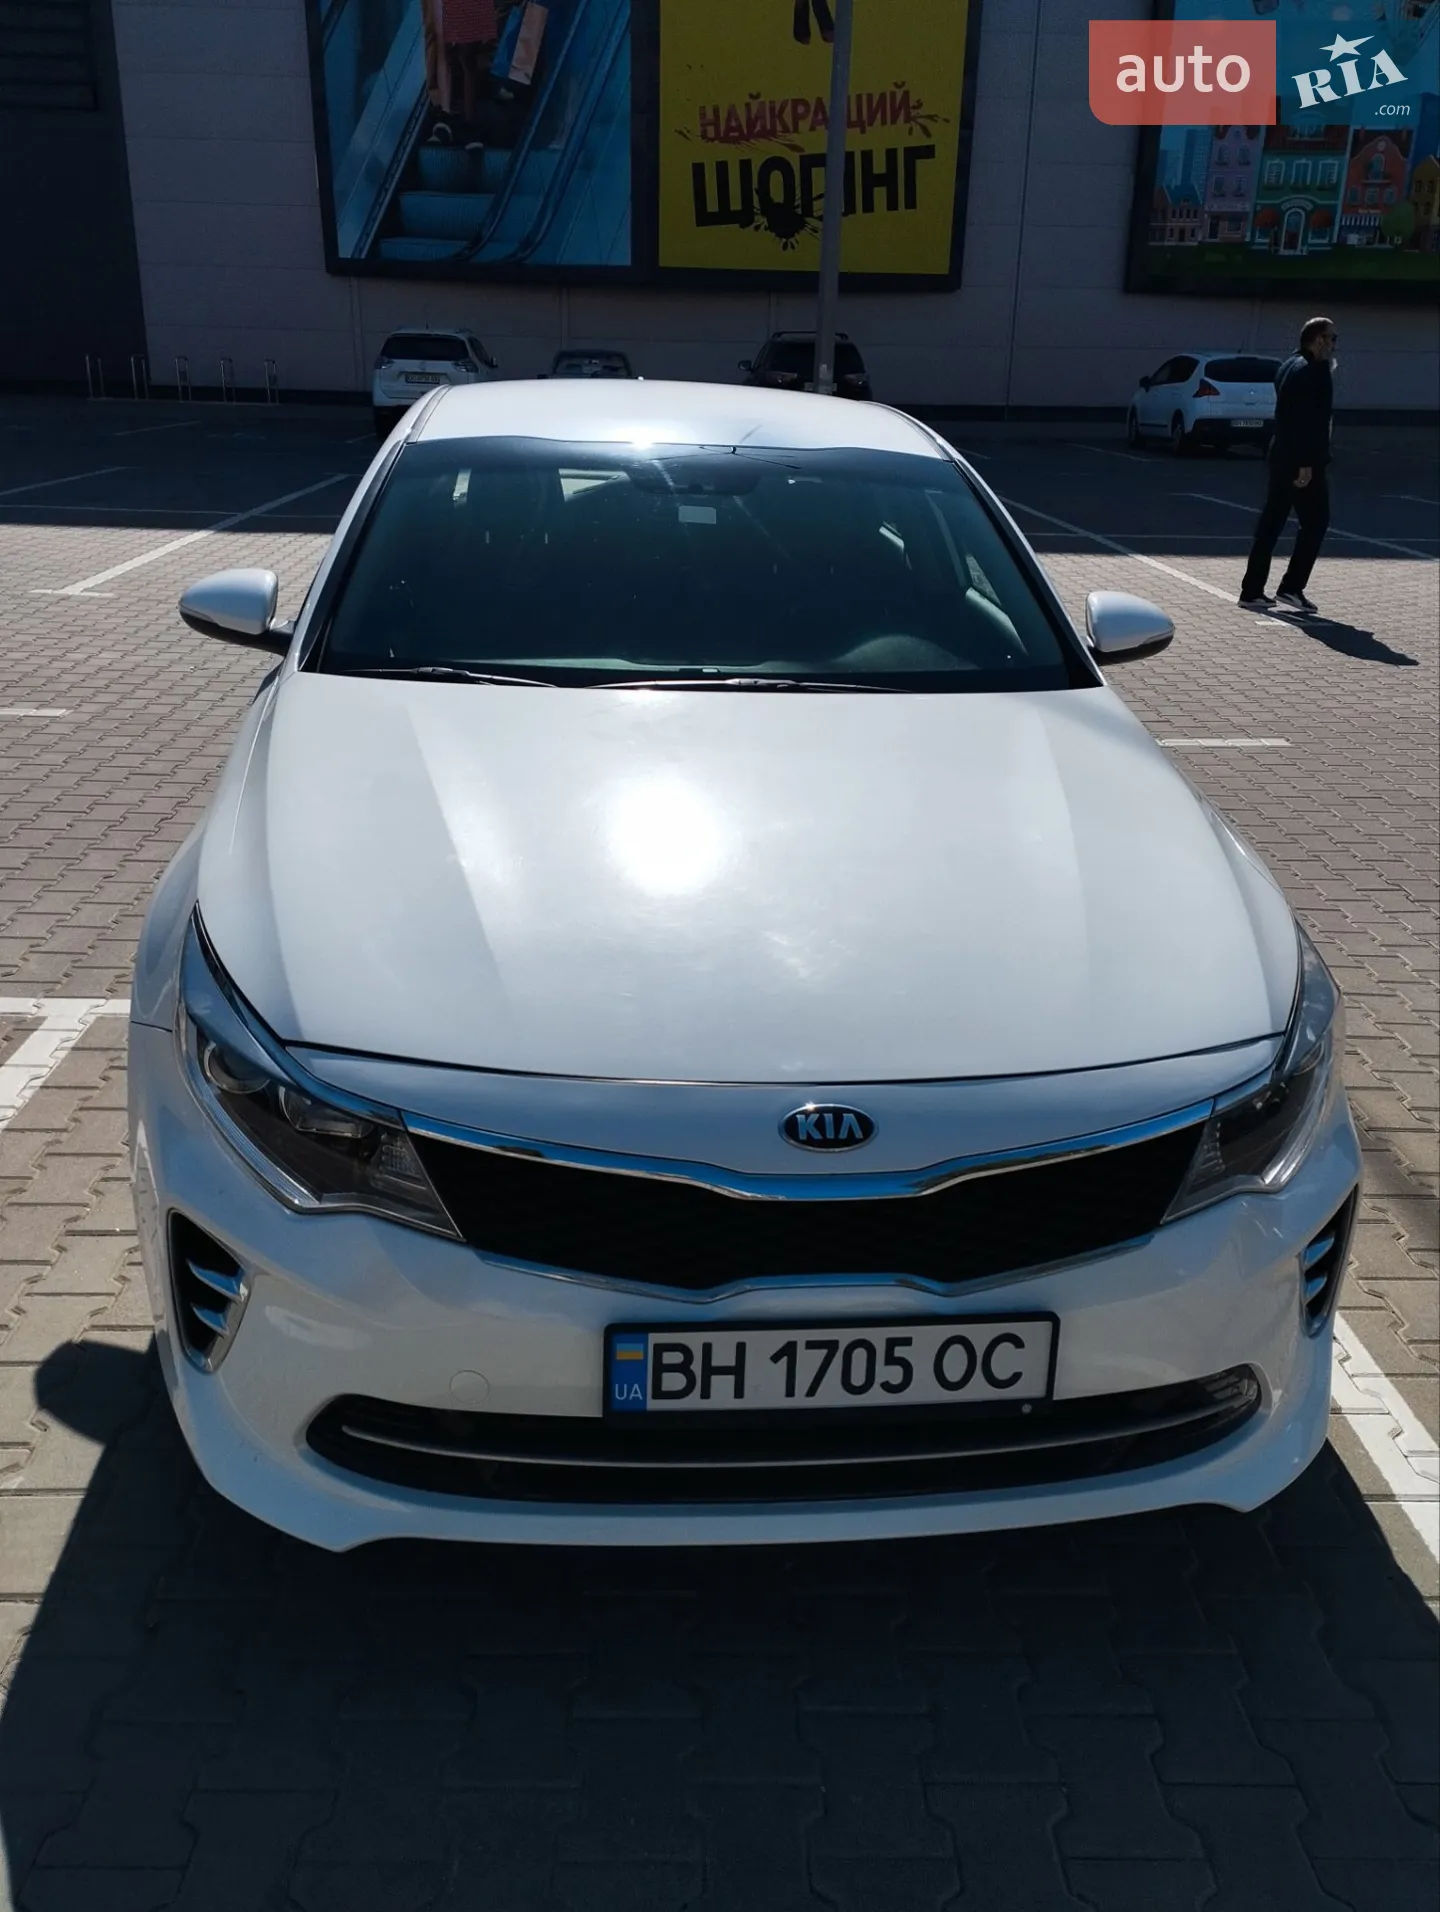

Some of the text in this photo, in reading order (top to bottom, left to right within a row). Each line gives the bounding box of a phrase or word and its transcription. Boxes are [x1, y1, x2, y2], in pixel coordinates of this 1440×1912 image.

[795, 1112, 864, 1140] KIA
[652, 1332, 1025, 1400] BH 1705 OC
[614, 1383, 643, 1401] UA
